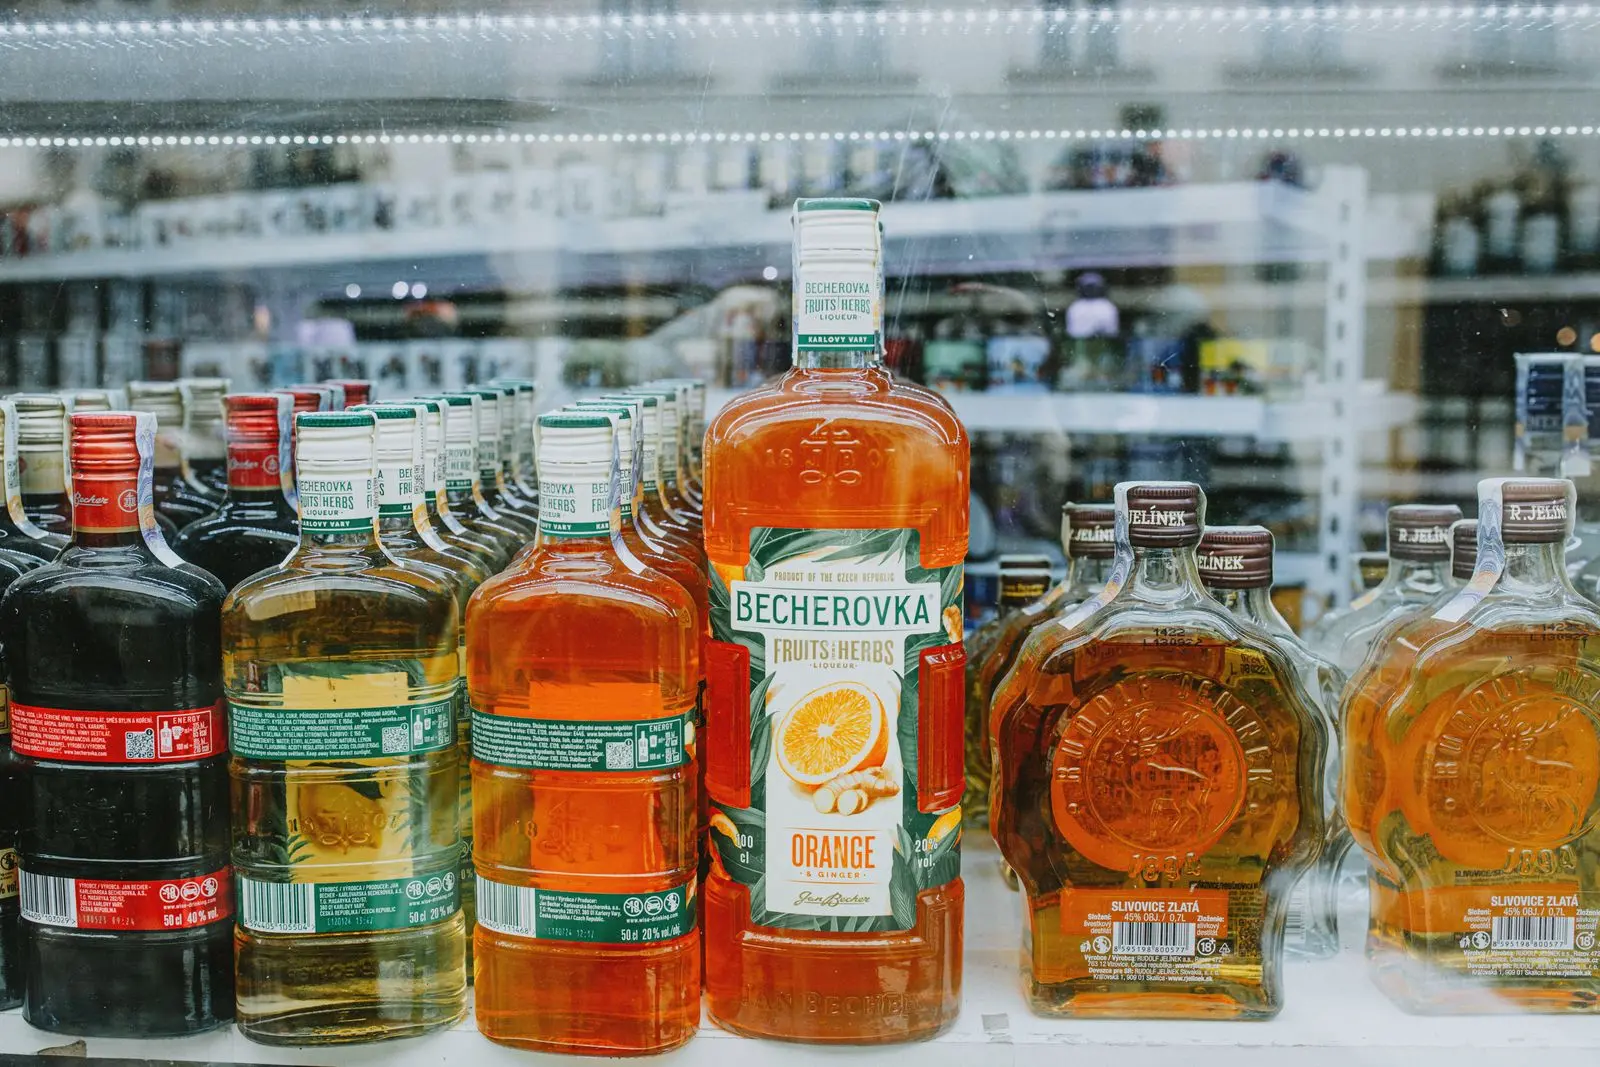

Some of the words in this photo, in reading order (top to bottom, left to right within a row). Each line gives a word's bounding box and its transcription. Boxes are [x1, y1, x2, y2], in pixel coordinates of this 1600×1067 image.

[804, 282, 870, 294] BECHEROVKA
[805, 298, 836, 315] FRUITS
[841, 298, 871, 315] HERBS
[808, 336, 846, 344] KARLOVY
[848, 336, 868, 344] VARY
[323, 496, 354, 510] HERBS
[774, 571, 805, 583] PRODUCT
[808, 572, 816, 583] OF
[820, 572, 833, 583] THE
[837, 572, 858, 583] CZECH
[862, 572, 895, 583] REPUBLIC
[736, 590, 930, 626] BECHEROVKA
[1153, 628, 1186, 637] 1422
[773, 637, 830, 665] FRUITS
[837, 638, 895, 666] HERBS
[173, 715, 200, 724] ENERGY
[650, 723, 673, 732] ENERGY
[736, 833, 754, 850] 100
[914, 839, 938, 853] 20%
[791, 833, 876, 869] ORANGE
[740, 852, 749, 864] cl
[918, 857, 936, 868] vol.
[818, 871, 860, 879] GINGER
[794, 890, 824, 906] Jan
[822, 892, 871, 908] Becher
[1491, 896, 1544, 907] SLIVOVICE
[1546, 894, 1579, 907] ZLATÁ
[1111, 901, 1165, 913] SLIVOVICE
[1168, 899, 1200, 913] ZLATÁ
[1504, 907, 1521, 916] 45%
[1522, 907, 1540, 916] OBJ.
[1549, 907, 1566, 917] 0,7L
[163, 914, 174, 926] 50
[175, 914, 182, 926] cl
[186, 910, 198, 923] 40
[199, 909, 207, 921] %
[208, 907, 219, 919] vol.
[409, 911, 419, 923] 50
[420, 911, 426, 922] cl
[430, 908, 439, 920] 20
[439, 905, 446, 918] %
[1124, 913, 1141, 921] 45%
[1143, 913, 1160, 921] OBJ.
[1170, 913, 1186, 922] 0,7L
[621, 928, 631, 941] 50
[632, 929, 638, 940] cl
[643, 928, 652, 939] 20
[652, 927, 660, 938] %
[1113, 945, 1118, 953] 8
[1121, 945, 1151, 953] 595198
[1155, 945, 1185, 953] 800577
